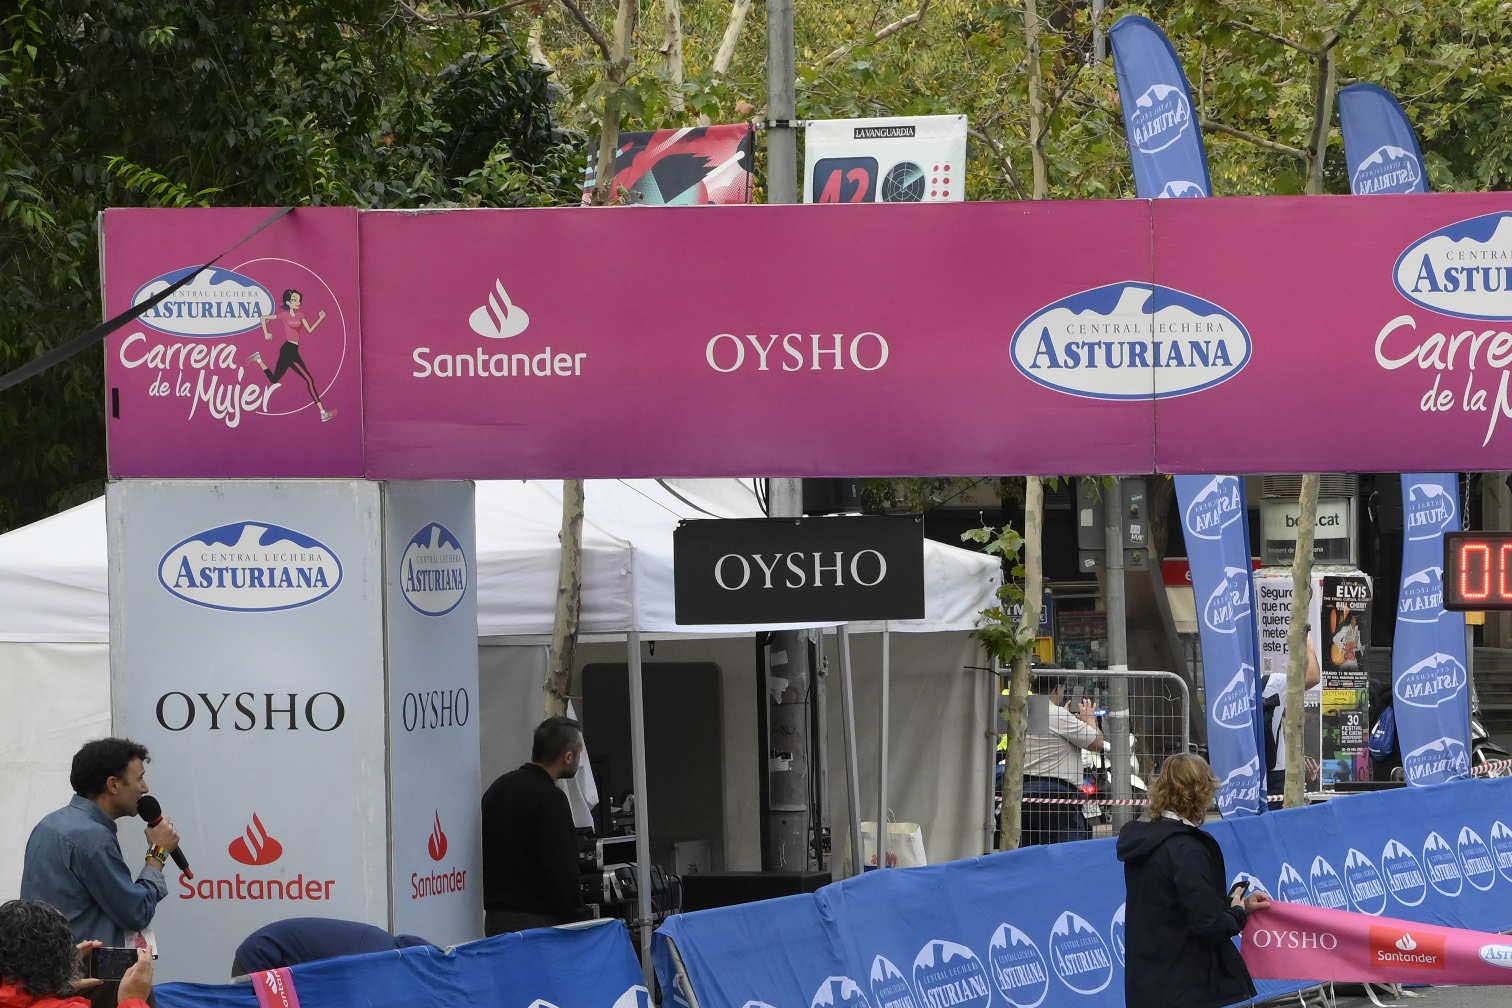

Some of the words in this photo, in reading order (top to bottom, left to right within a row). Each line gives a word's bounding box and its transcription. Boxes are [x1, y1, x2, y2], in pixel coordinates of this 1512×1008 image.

[1067, 322, 1141, 335] CENTRAL
[1149, 321, 1224, 333] LECHERA
[119, 332, 237, 370] Carrera
[412, 345, 587, 379] Santander
[705, 331, 889, 373] OYSHO
[1029, 326, 1233, 370] ASTURIANA
[149, 371, 170, 397] de
[175, 371, 191, 397] la
[188, 366, 282, 428] Mujer
[1420, 373, 1454, 412] de
[1463, 372, 1487, 412] la
[173, 555, 329, 588] ASTURIANA
[200, 553, 259, 562] CENTRAL
[264, 552, 323, 562] LECHERA
[714, 549, 887, 590] OYSHO
[406, 558, 464, 593] ASTURIANA
[1336, 585, 1367, 598] ELVIS
[1262, 602, 1277, 613] que
[1262, 613, 1293, 627] quiere
[1263, 627, 1288, 638] mete
[1263, 641, 1281, 652] este
[1283, 643, 1289, 654] p
[155, 691, 346, 732] OYSHO
[402, 687, 469, 732] OYSHO
[1347, 715, 1359, 725] 30
[179, 873, 336, 900] Santander
[411, 867, 466, 899] Santander
[1056, 945, 1110, 977] ASTURIANA
[1253, 929, 1338, 950] OYSHO
[1378, 950, 1437, 964] Santander
[995, 958, 1045, 990] ASTURIANA
